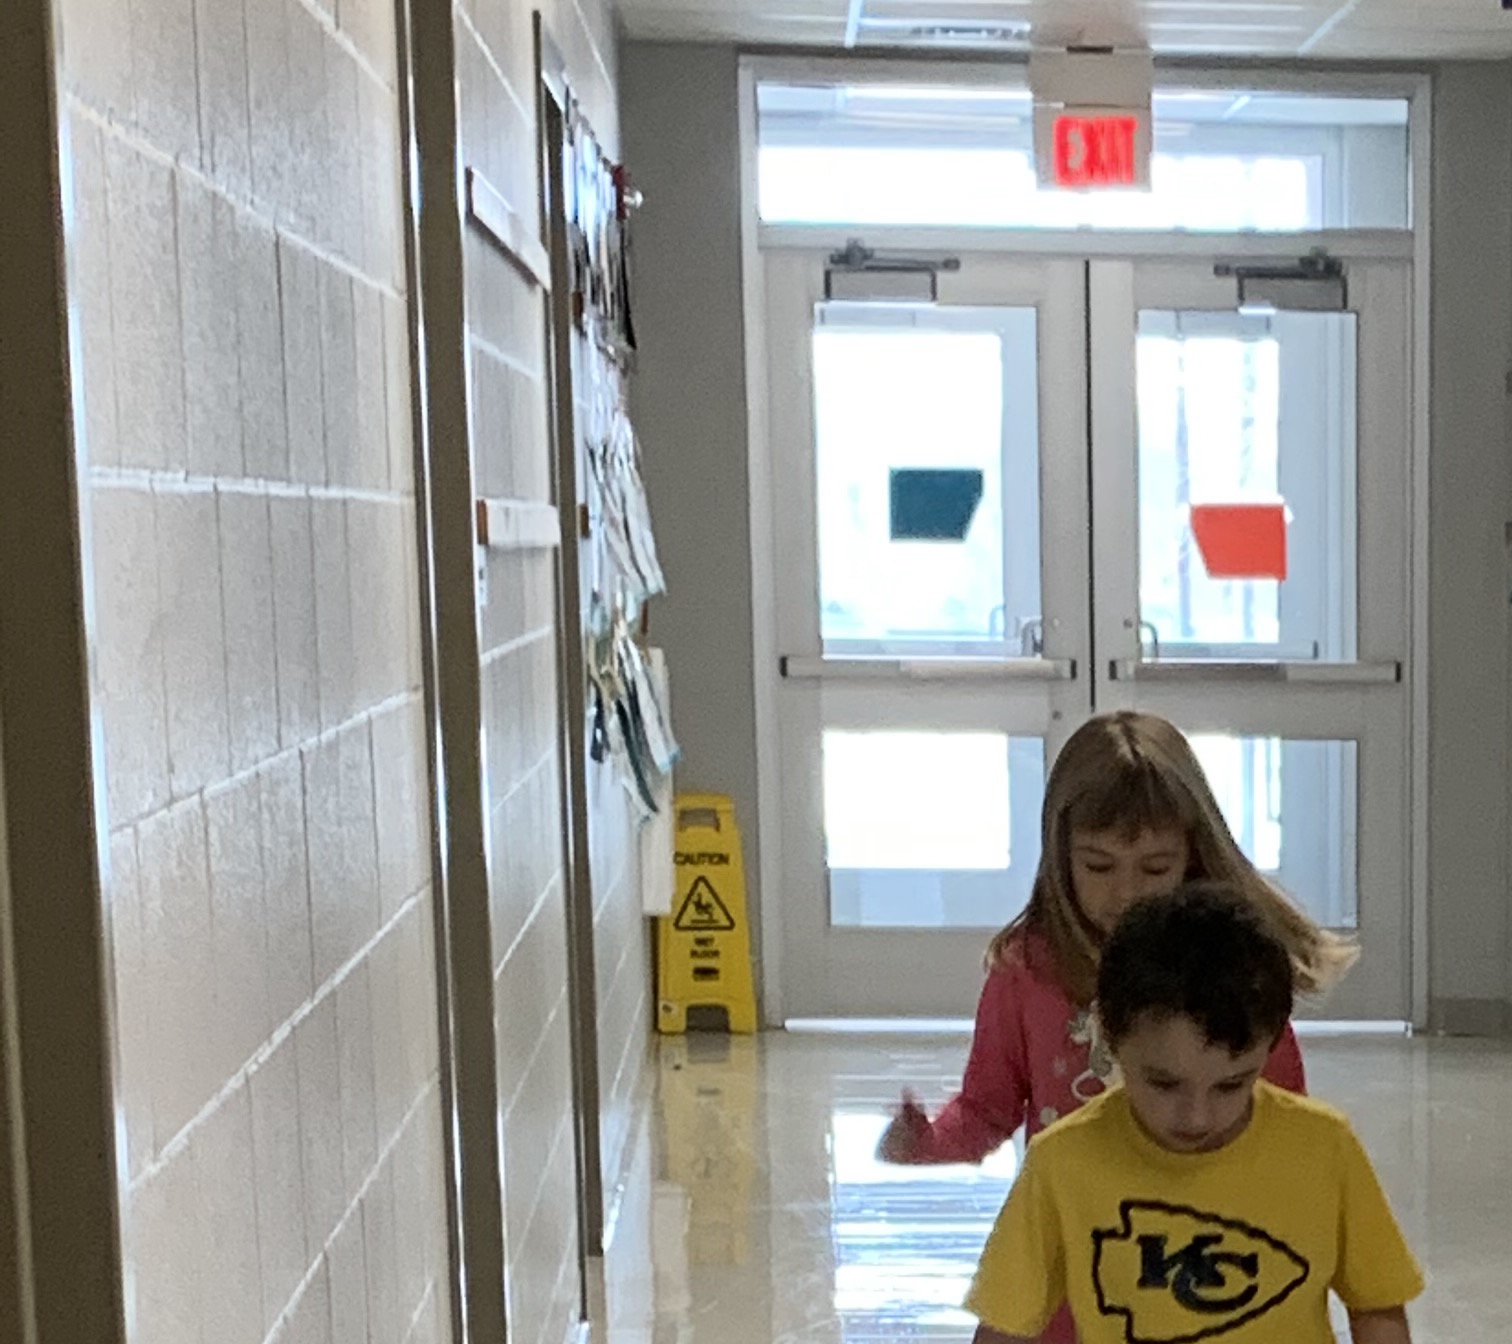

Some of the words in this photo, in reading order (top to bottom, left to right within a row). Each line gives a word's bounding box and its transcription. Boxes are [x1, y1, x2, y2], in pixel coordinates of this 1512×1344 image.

[1054, 115, 1137, 187] EXIT
[673, 852, 730, 865] CAUTION
[1137, 1233, 1258, 1313] KC
